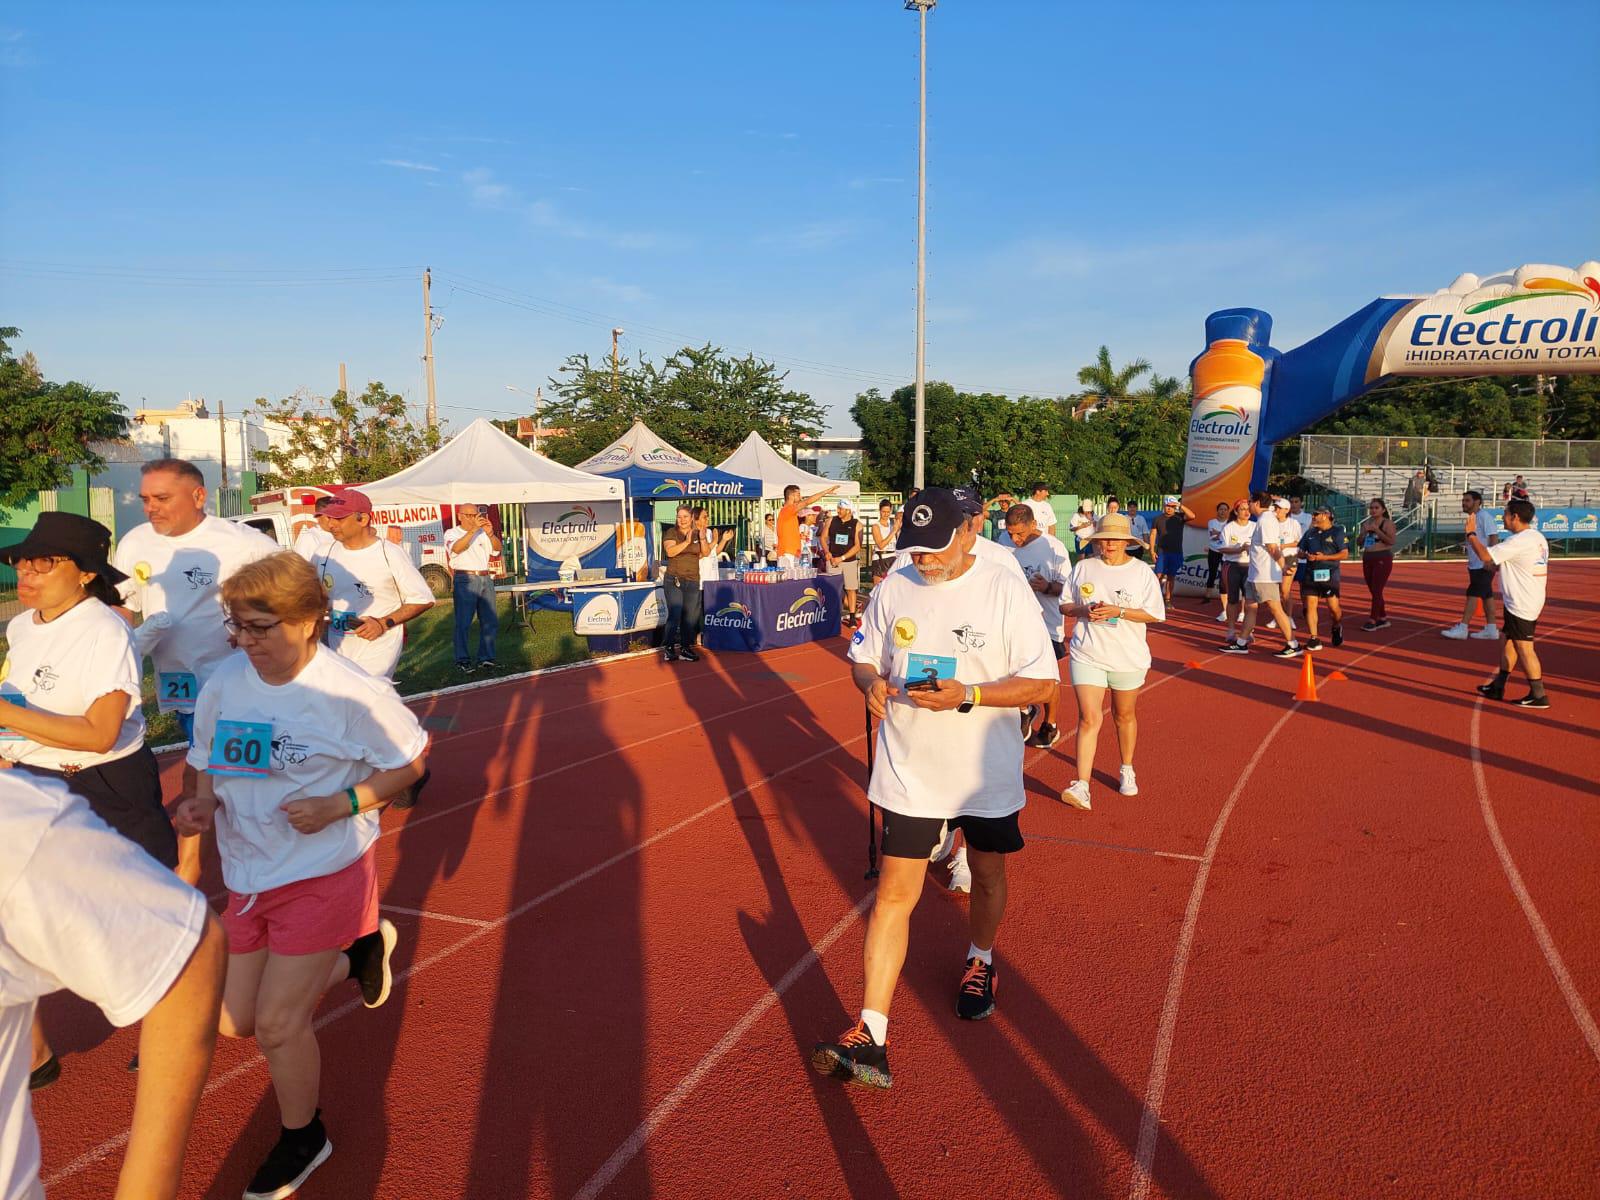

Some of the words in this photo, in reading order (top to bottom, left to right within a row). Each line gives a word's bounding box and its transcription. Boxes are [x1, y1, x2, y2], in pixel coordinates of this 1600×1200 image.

[1545, 346, 1600, 359] TOTA
[1190, 419, 1253, 436] Electrolit
[687, 479, 744, 495] Electrolit
[370, 506, 438, 525] MBULANCIA
[541, 520, 598, 535] Electrolit
[418, 533, 436, 543] 3615
[704, 614, 753, 630] Electrolit
[776, 606, 828, 632] Electrolit
[167, 681, 190, 698] 21
[223, 737, 261, 765] 60
